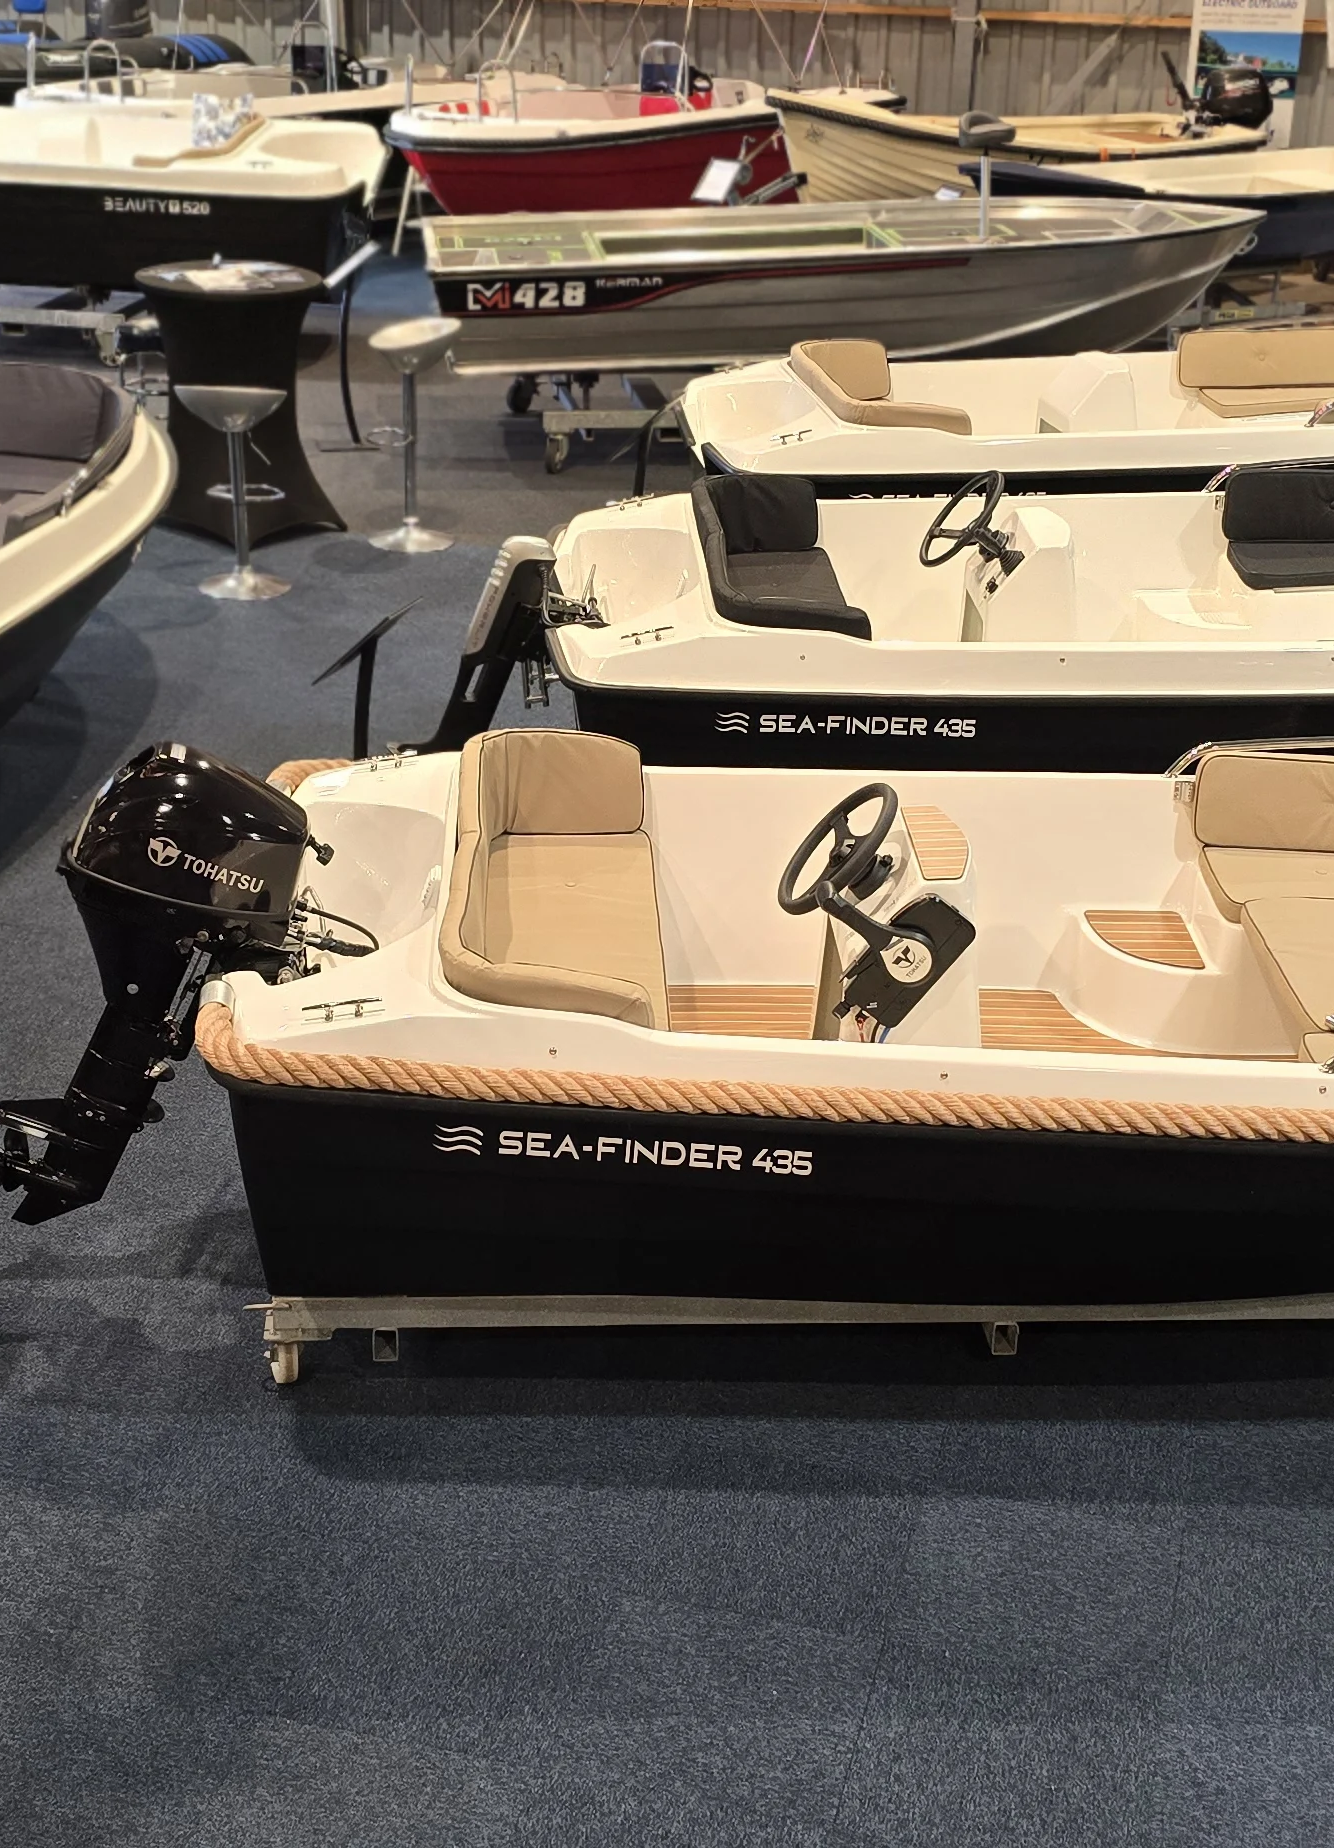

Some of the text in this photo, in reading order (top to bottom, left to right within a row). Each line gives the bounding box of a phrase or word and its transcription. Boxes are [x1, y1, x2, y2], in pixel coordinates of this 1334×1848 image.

[103, 196, 210, 215] BEAUTY 520
[513, 281, 586, 309] 428
[759, 714, 976, 738] SEA-FINDER 435
[183, 853, 264, 893] TOHATSU
[906, 955, 927, 978] TOHATSU
[498, 1130, 814, 1176] SEA-FINDER 435
